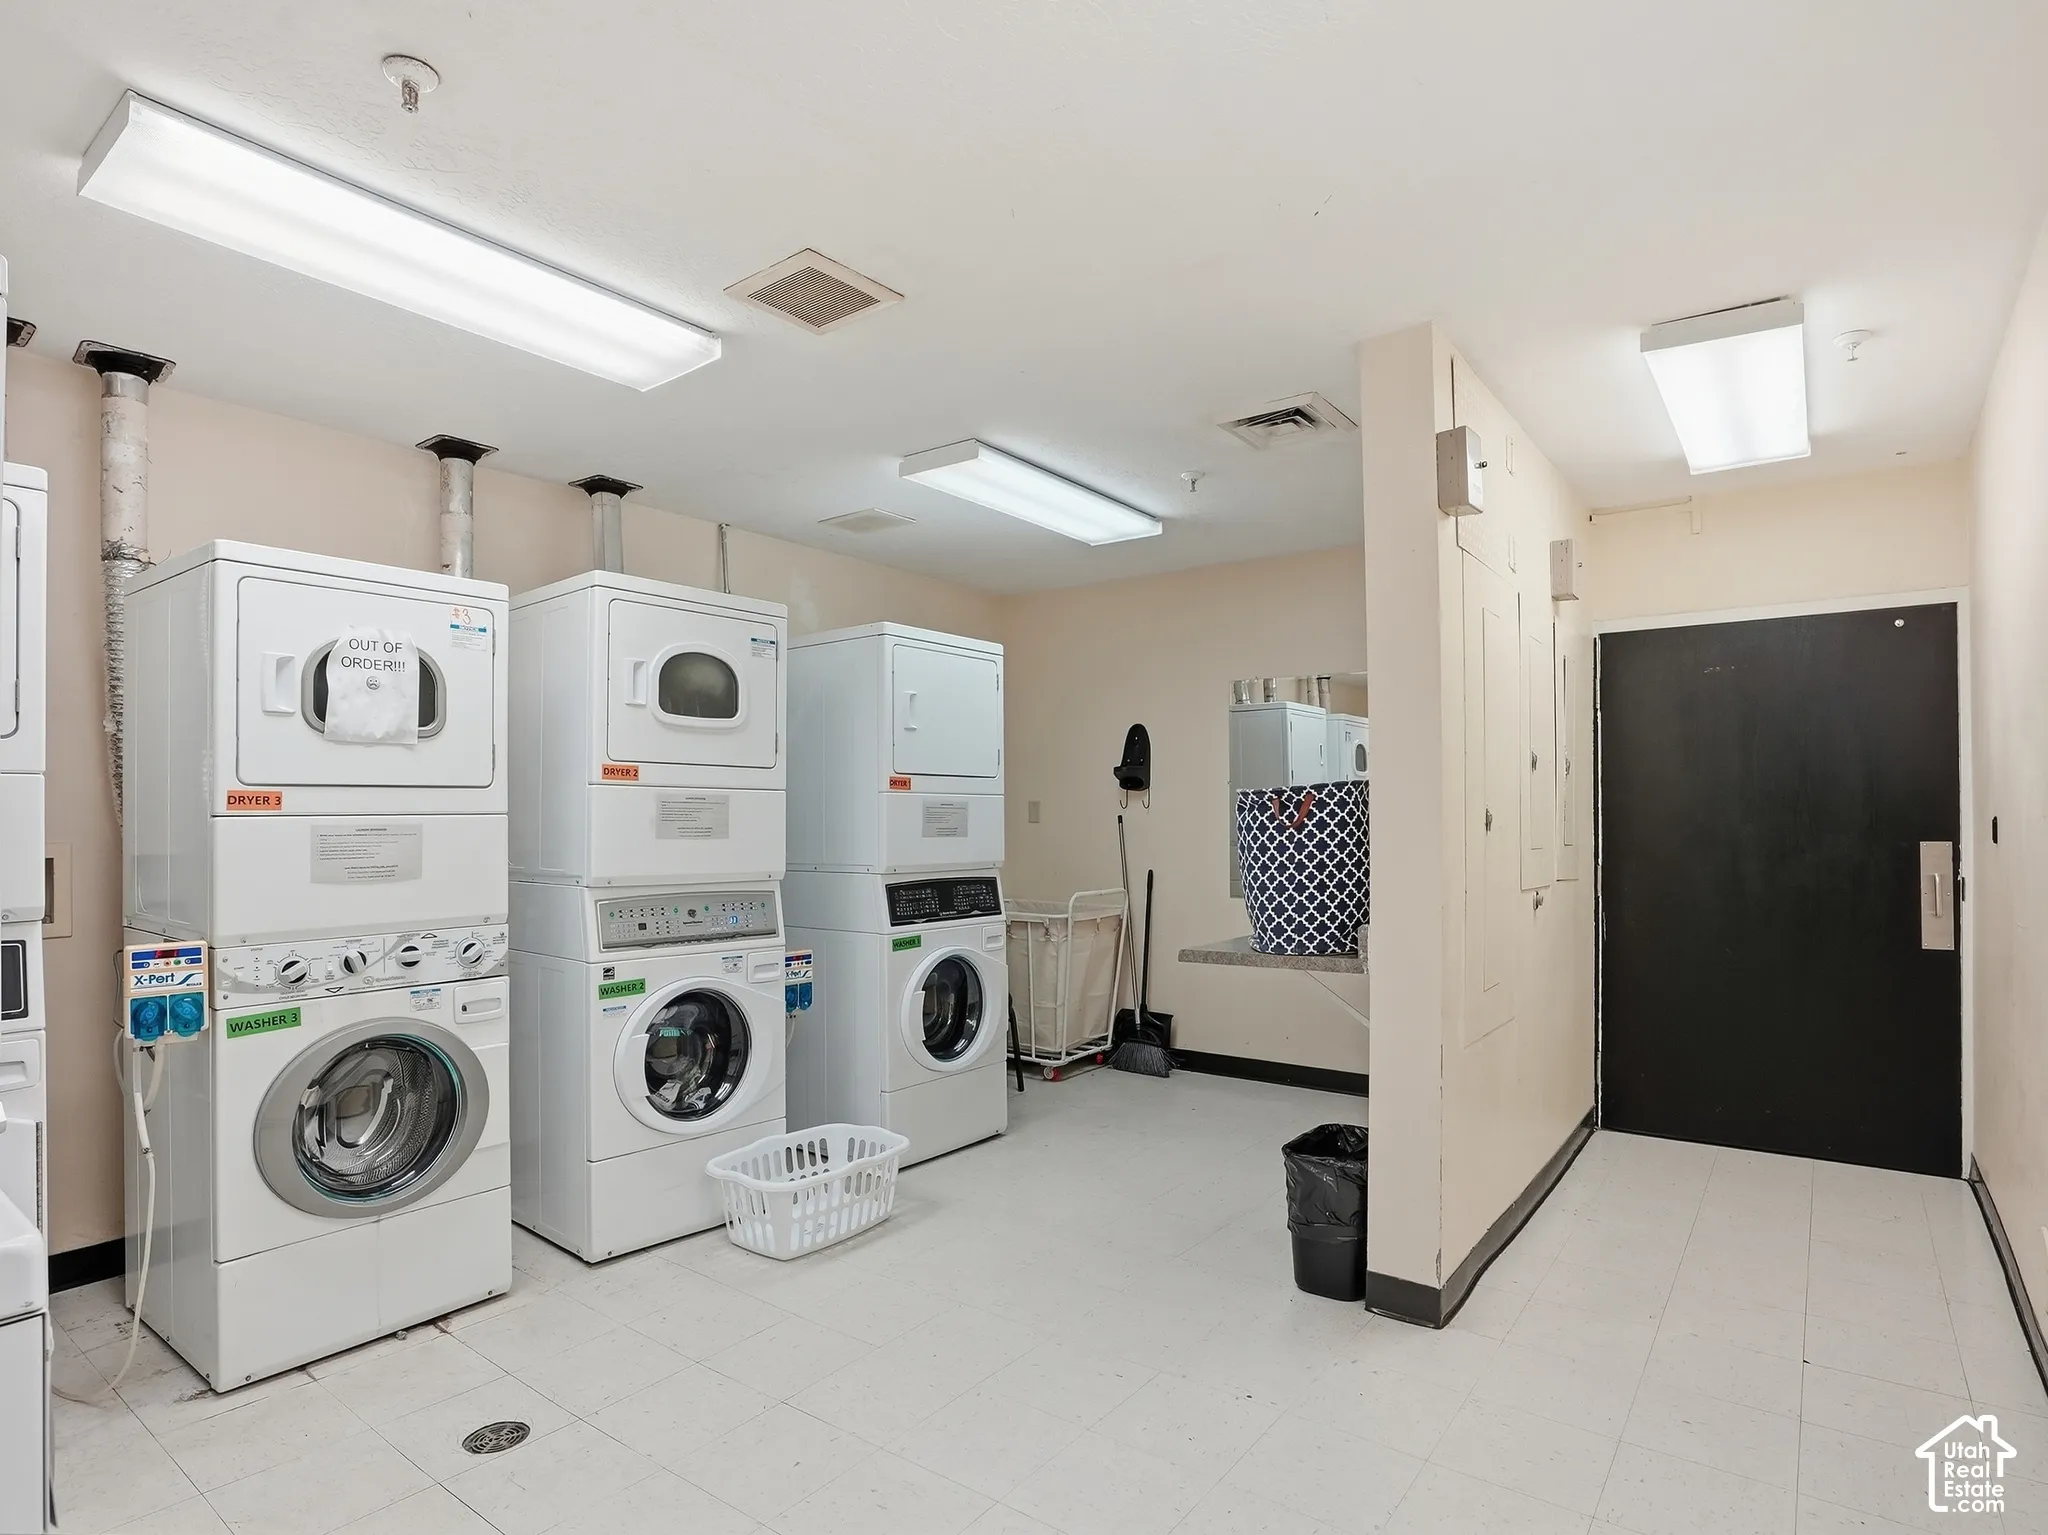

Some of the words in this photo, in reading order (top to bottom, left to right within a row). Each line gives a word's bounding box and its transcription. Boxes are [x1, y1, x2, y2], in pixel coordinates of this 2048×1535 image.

[349, 638, 379, 652] OUT
[383, 642, 403, 654] OF
[341, 656, 405, 672] ORDER!!!
[604, 767, 631, 777] DRYER
[633, 769, 639, 778] 2
[227, 795, 271, 805] DRYER
[274, 796, 282, 806] 3
[893, 939, 916, 948] WASHER
[134, 973, 175, 986] X-Pert
[601, 983, 637, 995] WASHER
[639, 982, 644, 990] 2
[229, 1015, 287, 1032] WASHER
[291, 1013, 298, 1022] 3
